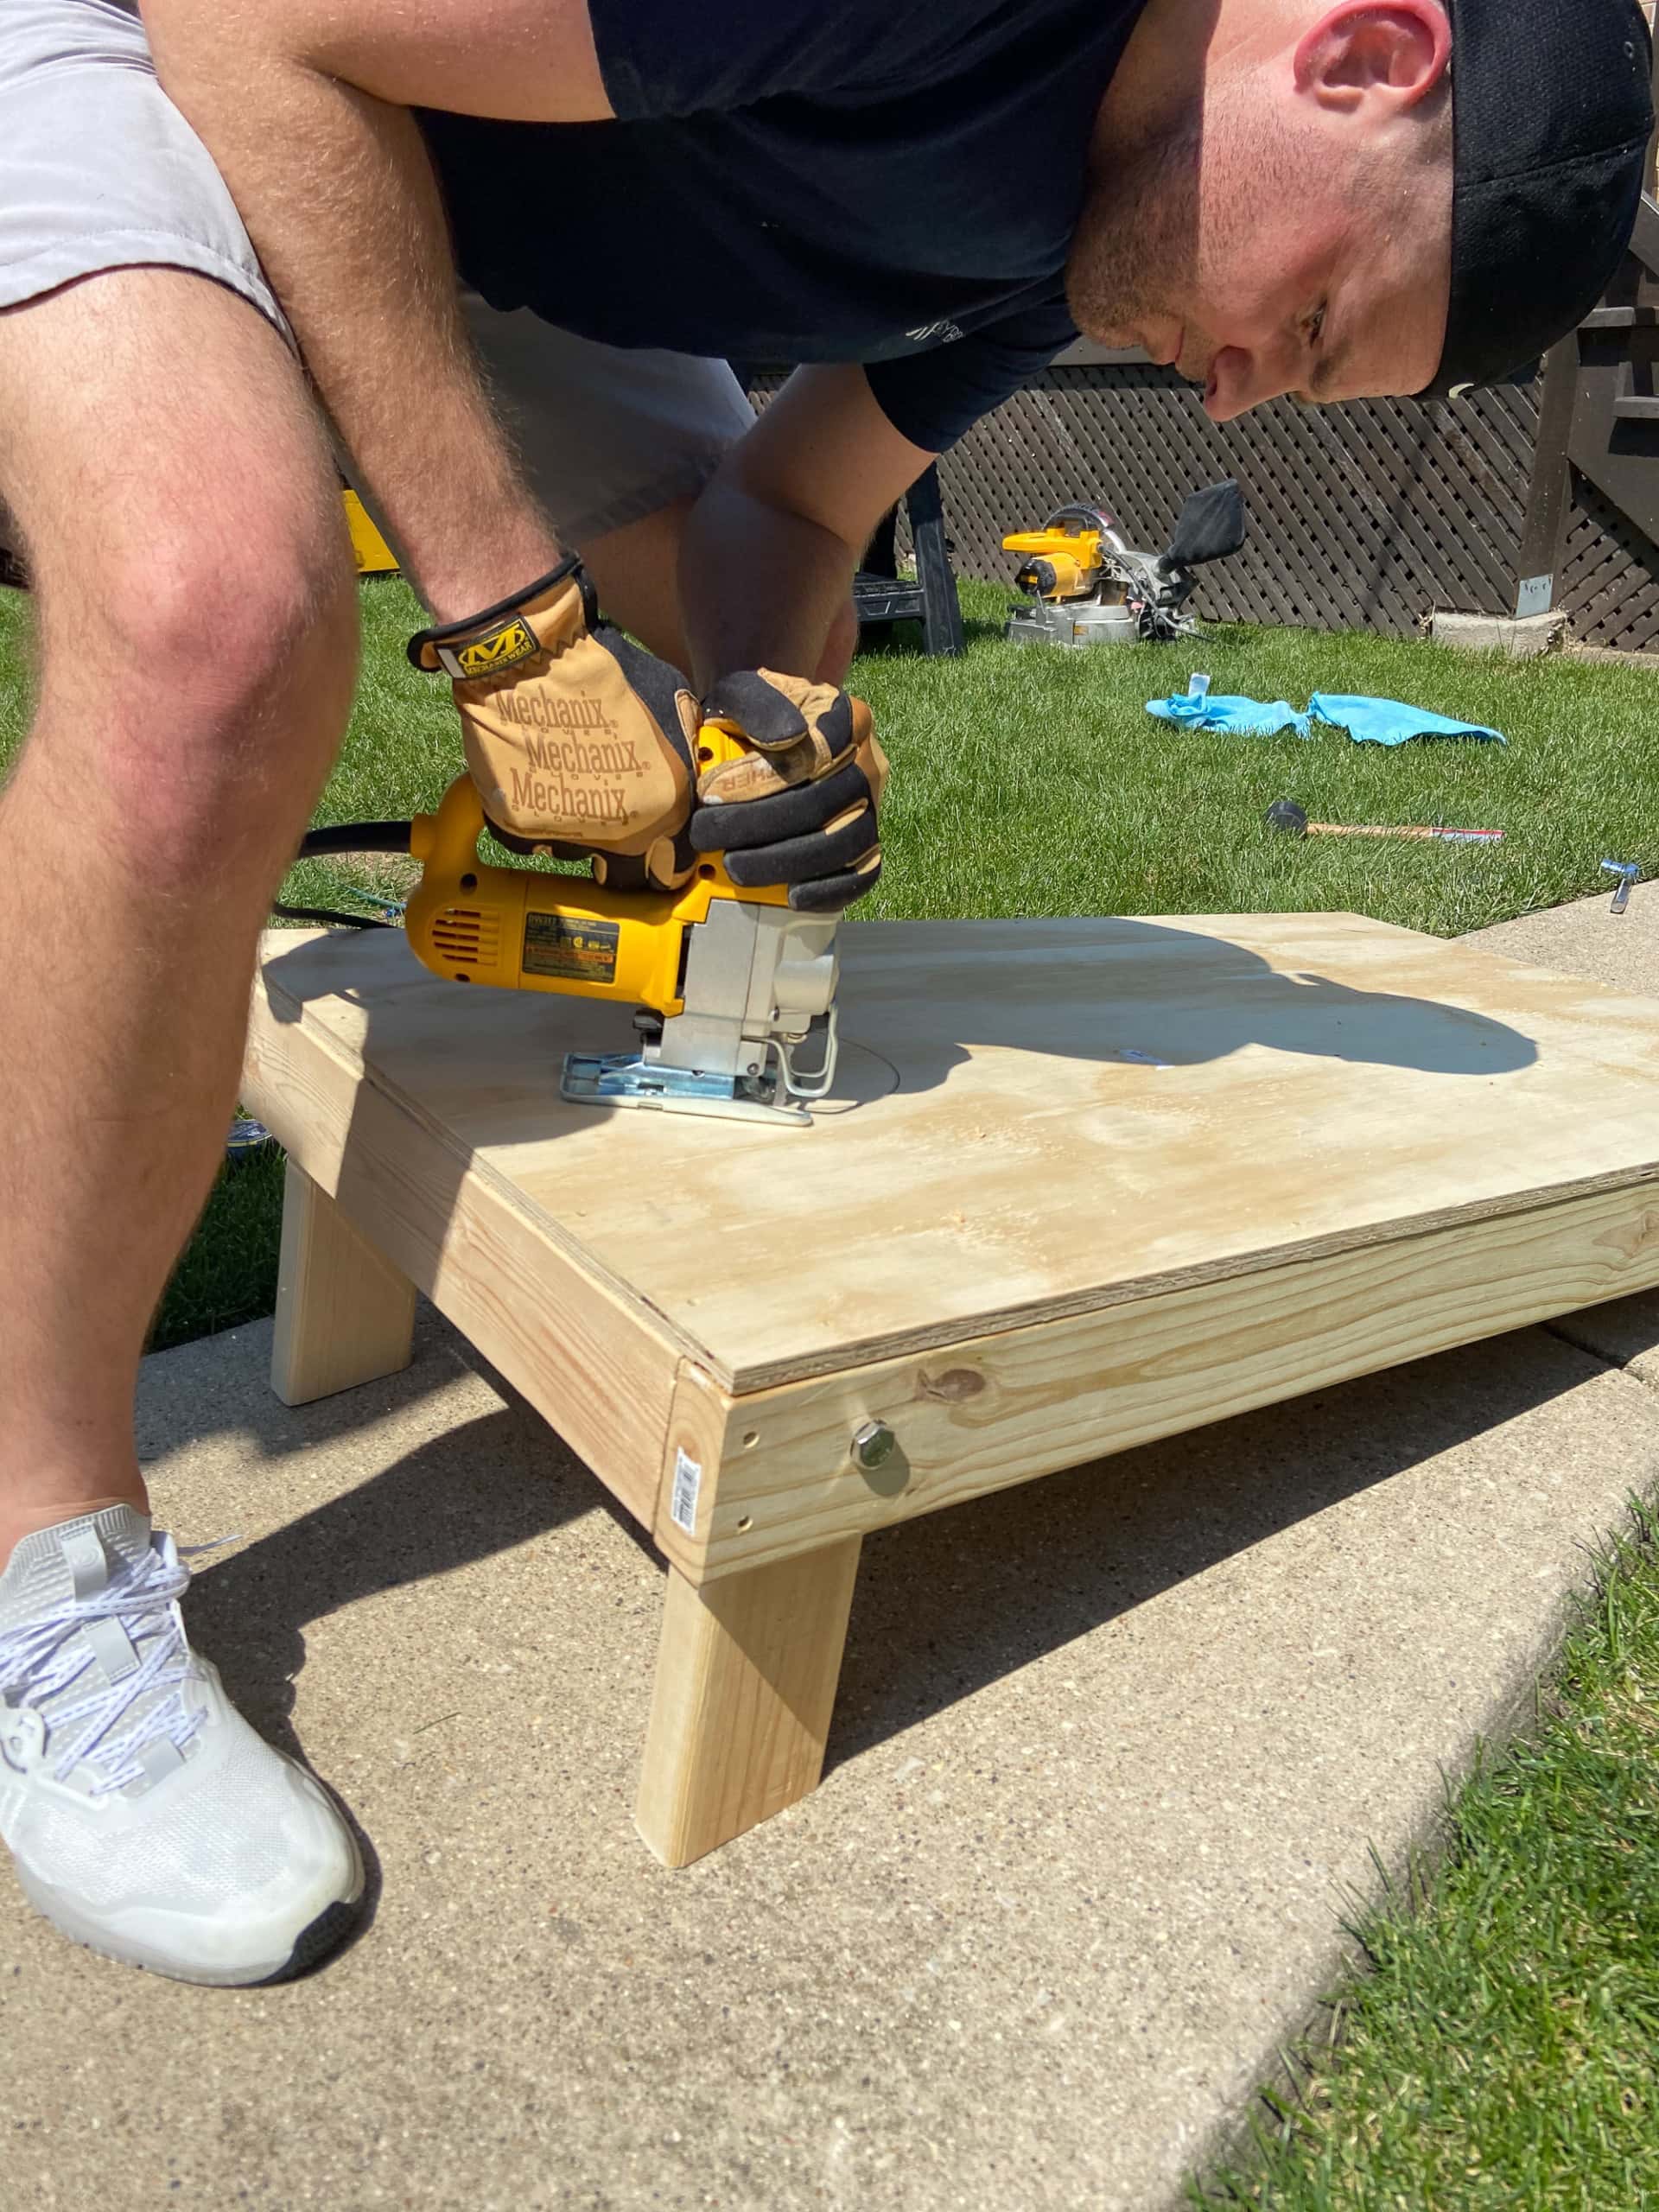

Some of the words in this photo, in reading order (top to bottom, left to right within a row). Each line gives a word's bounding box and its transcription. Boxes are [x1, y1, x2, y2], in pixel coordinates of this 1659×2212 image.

[496, 683, 610, 728] Mechanix
[524, 732, 642, 773] Mechanix
[510, 767, 629, 823] Mechanix
